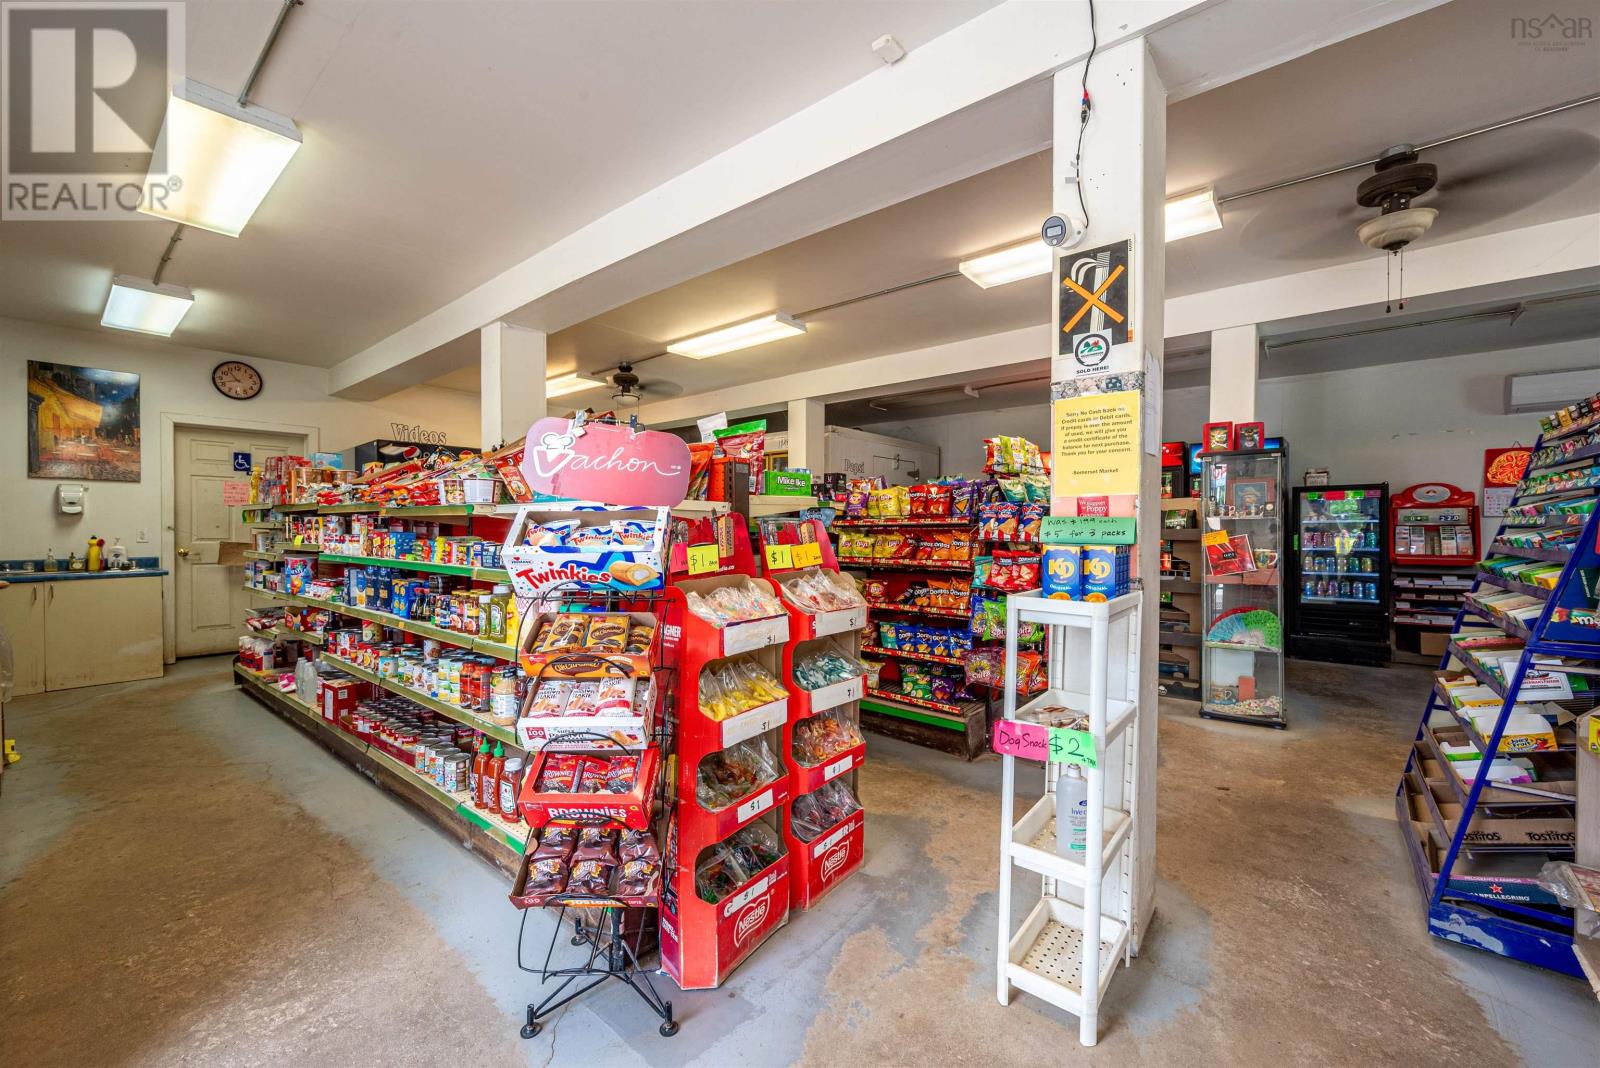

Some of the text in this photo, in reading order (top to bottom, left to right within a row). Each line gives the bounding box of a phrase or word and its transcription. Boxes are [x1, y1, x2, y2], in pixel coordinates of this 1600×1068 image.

[390, 422, 447, 444] Videos
[777, 476, 795, 485] Mike
[1101, 530, 1127, 539] packs
[515, 561, 612, 590] Twinkies
[1000, 730, 1047, 750] Dog Snack
